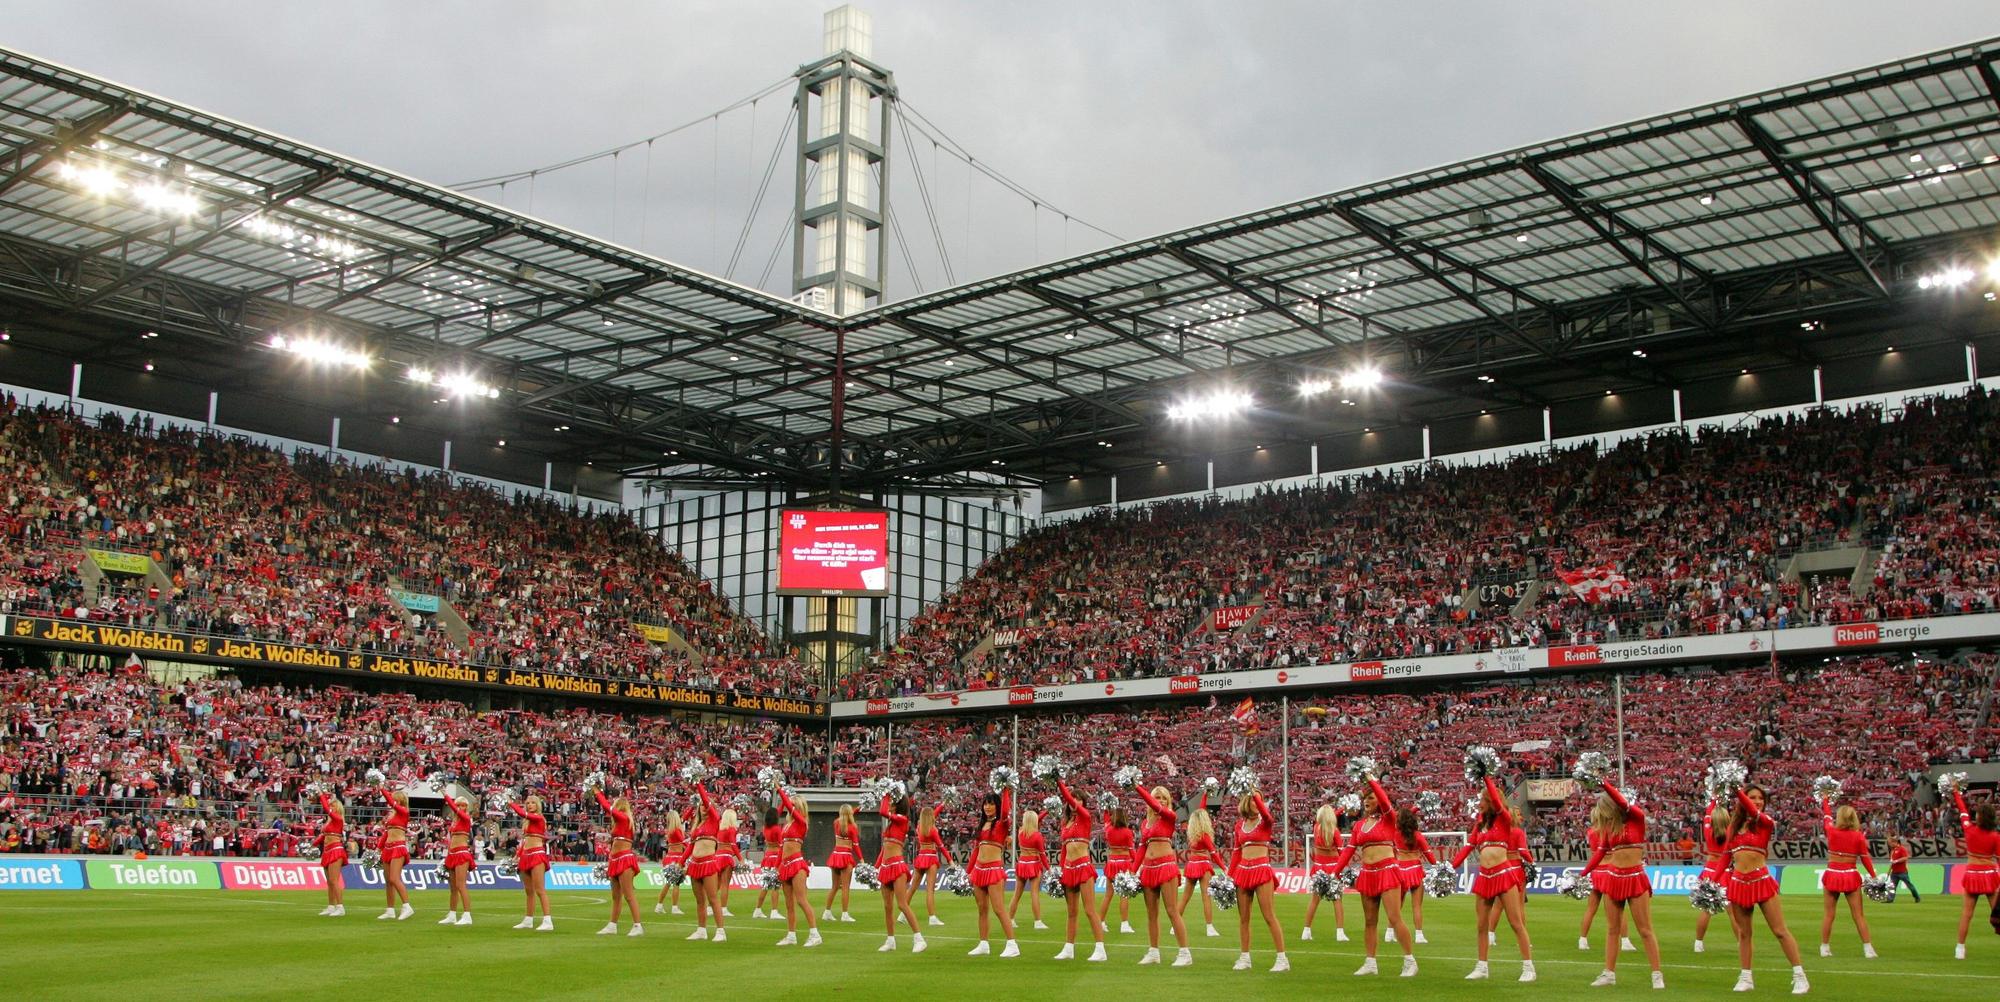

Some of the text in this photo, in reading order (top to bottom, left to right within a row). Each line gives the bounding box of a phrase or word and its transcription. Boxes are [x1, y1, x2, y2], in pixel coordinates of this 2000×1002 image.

[43, 622, 184, 652] Jack Wolfskin
[1837, 624, 1930, 641] RheinEnergie
[217, 640, 340, 668] Jack Wolfskin
[370, 656, 479, 682] Jack Wolfskin
[1352, 663, 1422, 677] RheinEnergie
[505, 671, 602, 694] Jack Wolfskin
[1171, 677, 1233, 690] RheinEnergie
[624, 683, 711, 704] Jack Wolfskin
[733, 694, 810, 714] Jack Wolfskin
[1010, 689, 1064, 701] RheinEnergie
[867, 700, 915, 711] RheinEnergie
[0, 863, 63, 884] ernet
[111, 864, 198, 885] Telefon
[235, 865, 306, 888] Digital
